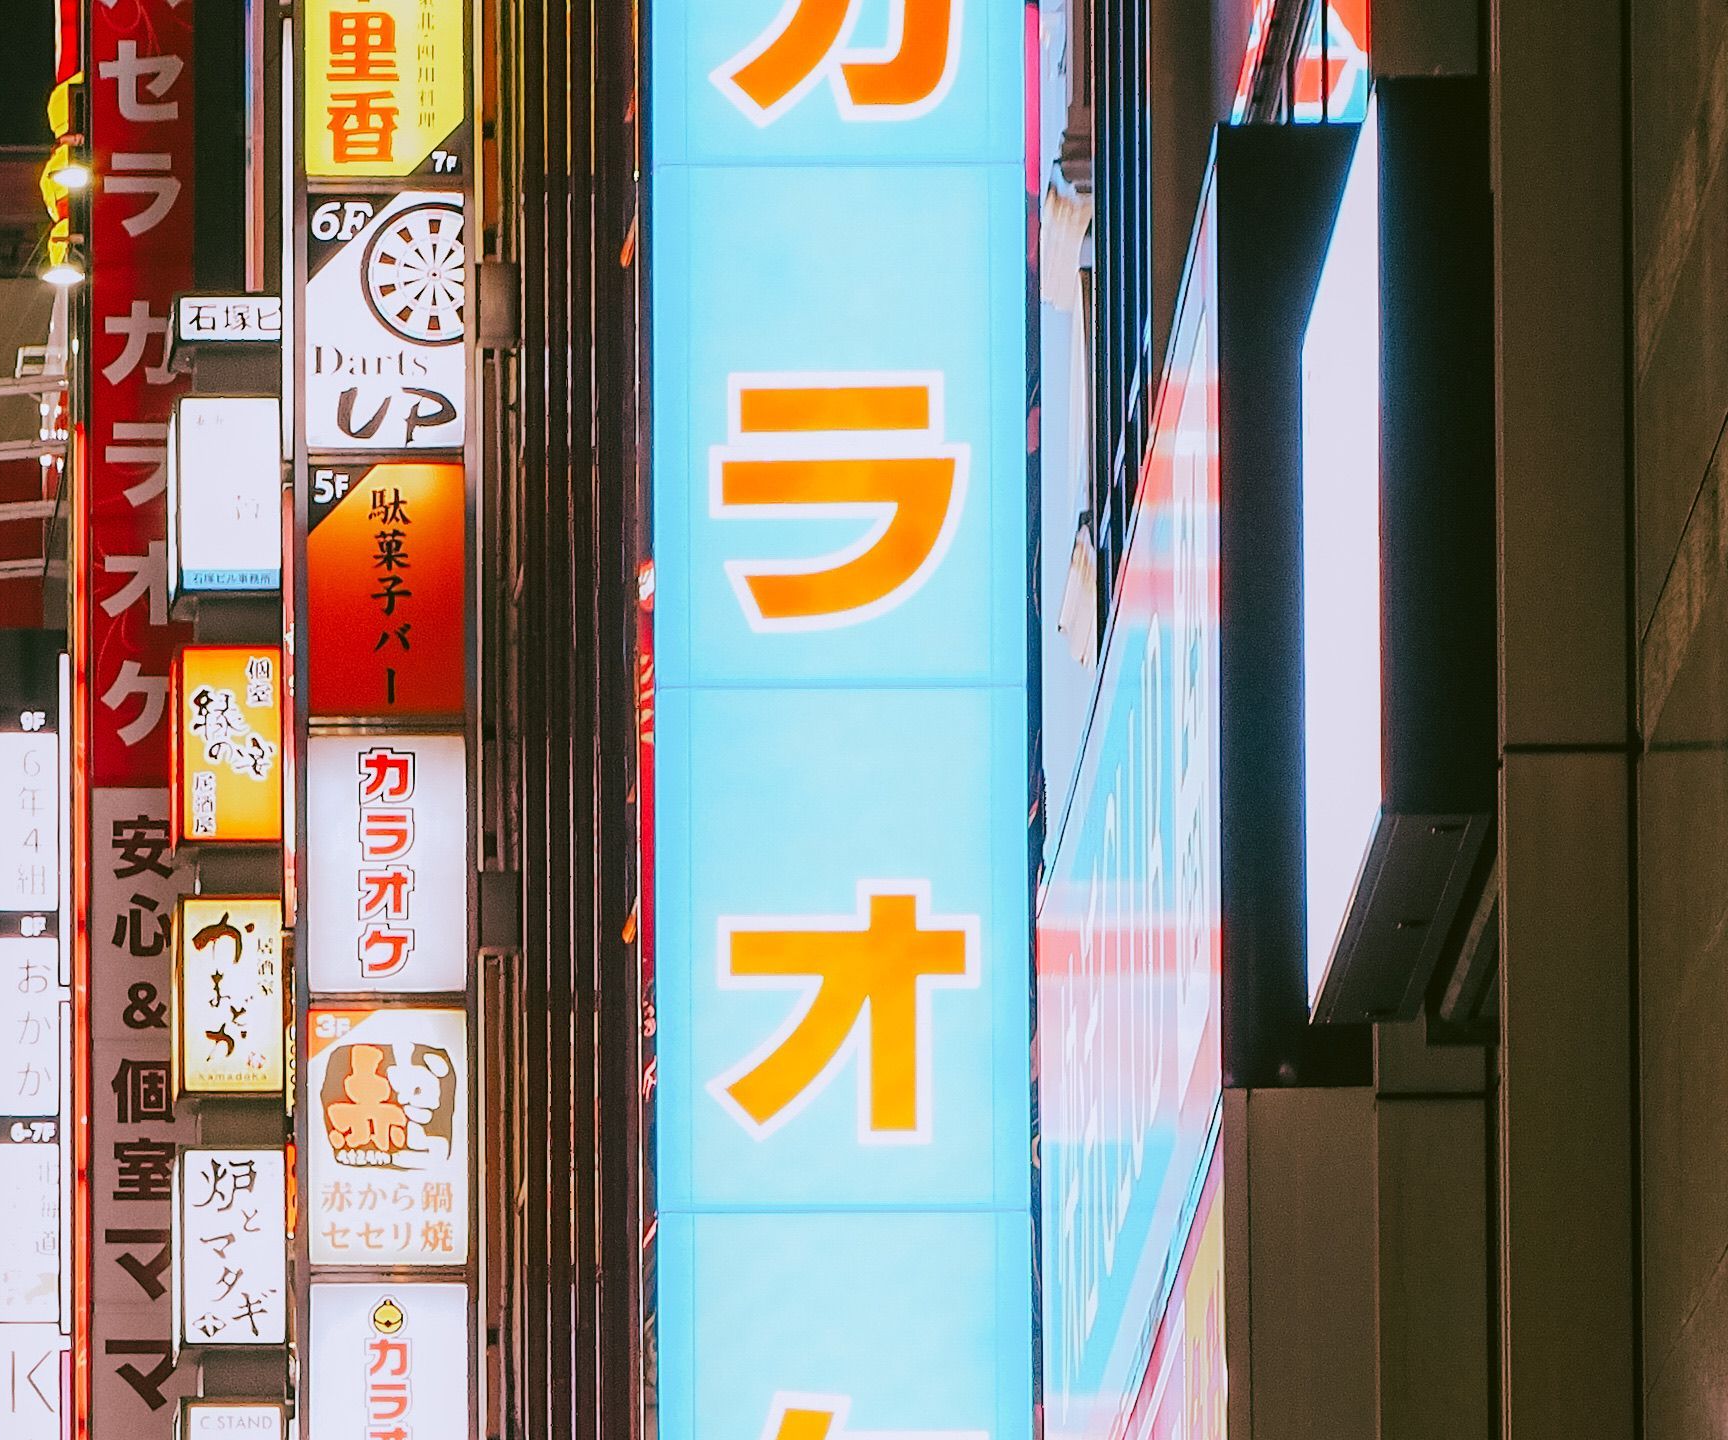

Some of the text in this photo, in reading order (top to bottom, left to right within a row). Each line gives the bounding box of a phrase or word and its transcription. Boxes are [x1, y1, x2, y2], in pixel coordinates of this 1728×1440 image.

[99, 0, 183, 237] セラ
[432, 151, 457, 173] 7F
[311, 202, 373, 241] 6F
[312, 343, 428, 377] Darts
[336, 387, 458, 443] UP
[313, 470, 349, 504] 5F
[367, 488, 411, 704] 駄菓子バー
[248, 659, 271, 702] 個室
[20, 711, 46, 732] 9F
[16, 748, 47, 896] 6年4組
[363, 752, 410, 973] カラオケ
[16, 957, 51, 1099] おかか
[315, 1014, 351, 1038] 3F
[320, 1181, 455, 1214] 赤から鍋
[321, 1220, 455, 1253] セセリ焼
[217, 1416, 273, 1430] STAND
